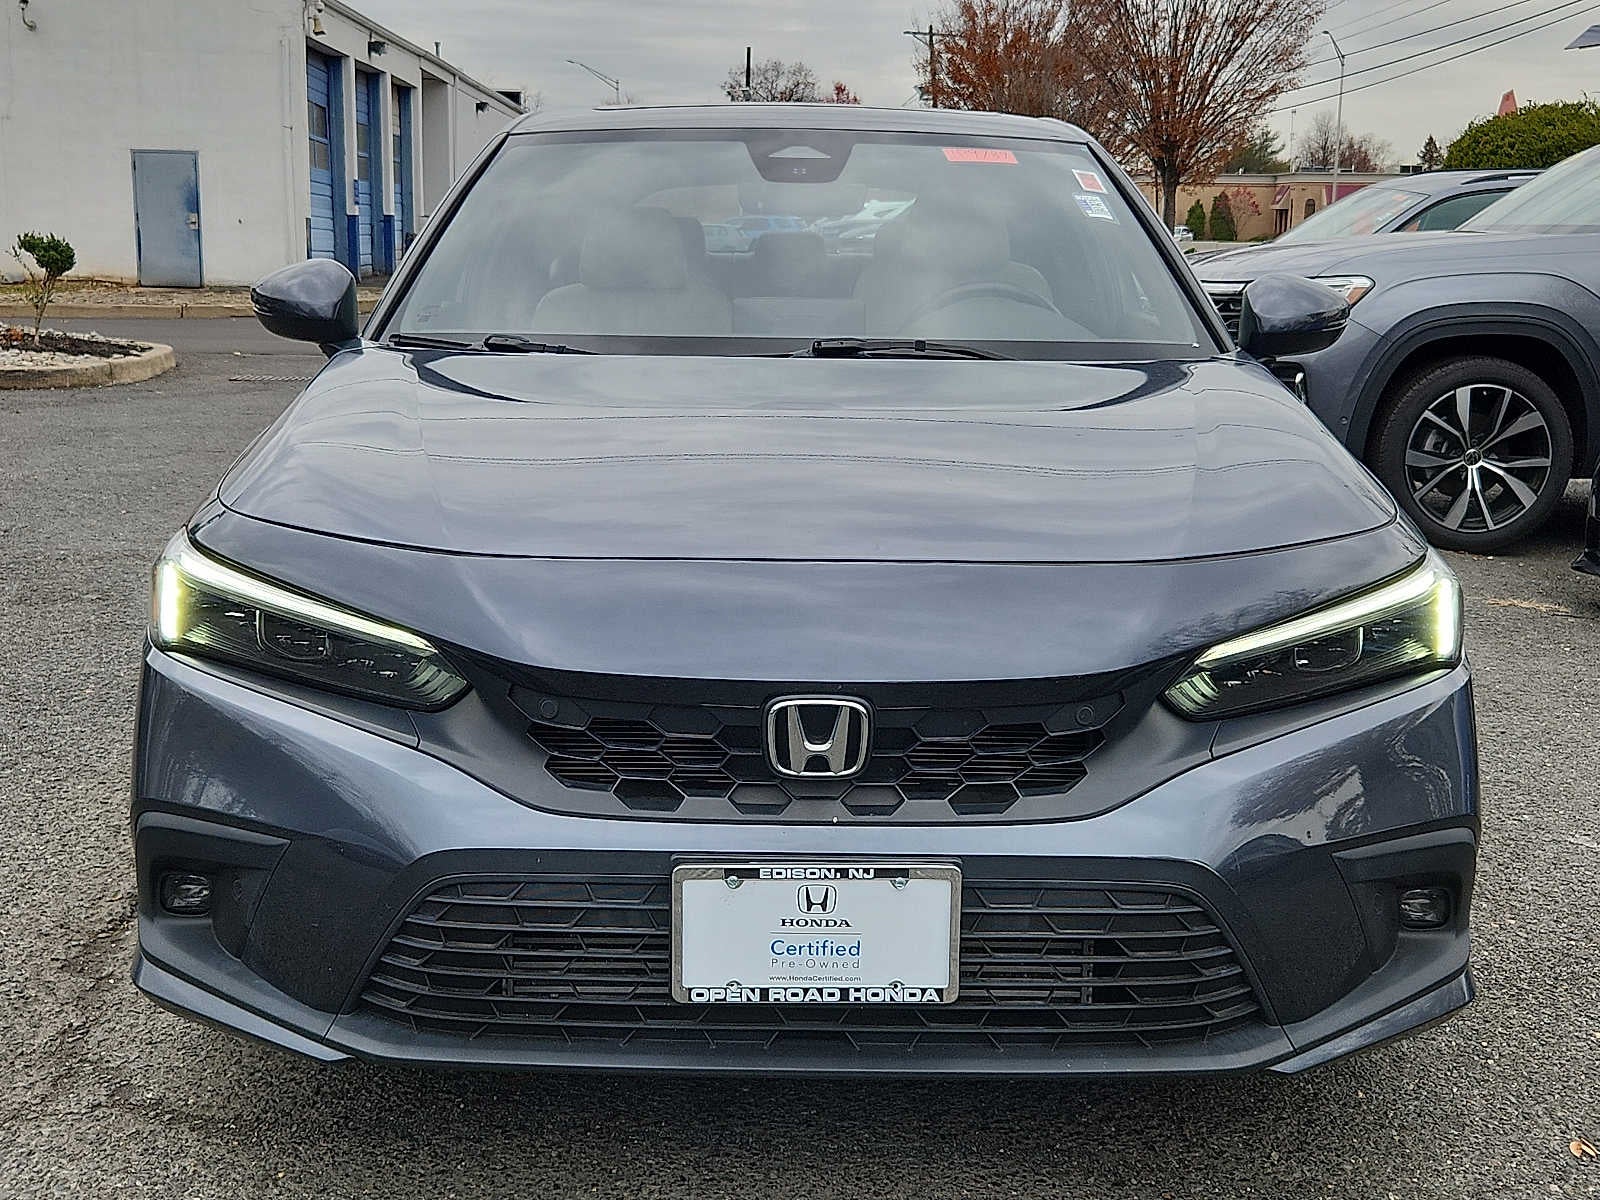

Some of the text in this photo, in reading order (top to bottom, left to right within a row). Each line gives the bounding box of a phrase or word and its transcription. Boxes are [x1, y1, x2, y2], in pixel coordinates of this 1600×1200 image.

[759, 868, 875, 880] EDISON, NJ
[780, 918, 852, 928] HONDA
[770, 939, 861, 957] Certified
[771, 958, 860, 969] Pre-Owned
[690, 987, 941, 1003] OPEN ROAD HONDA
